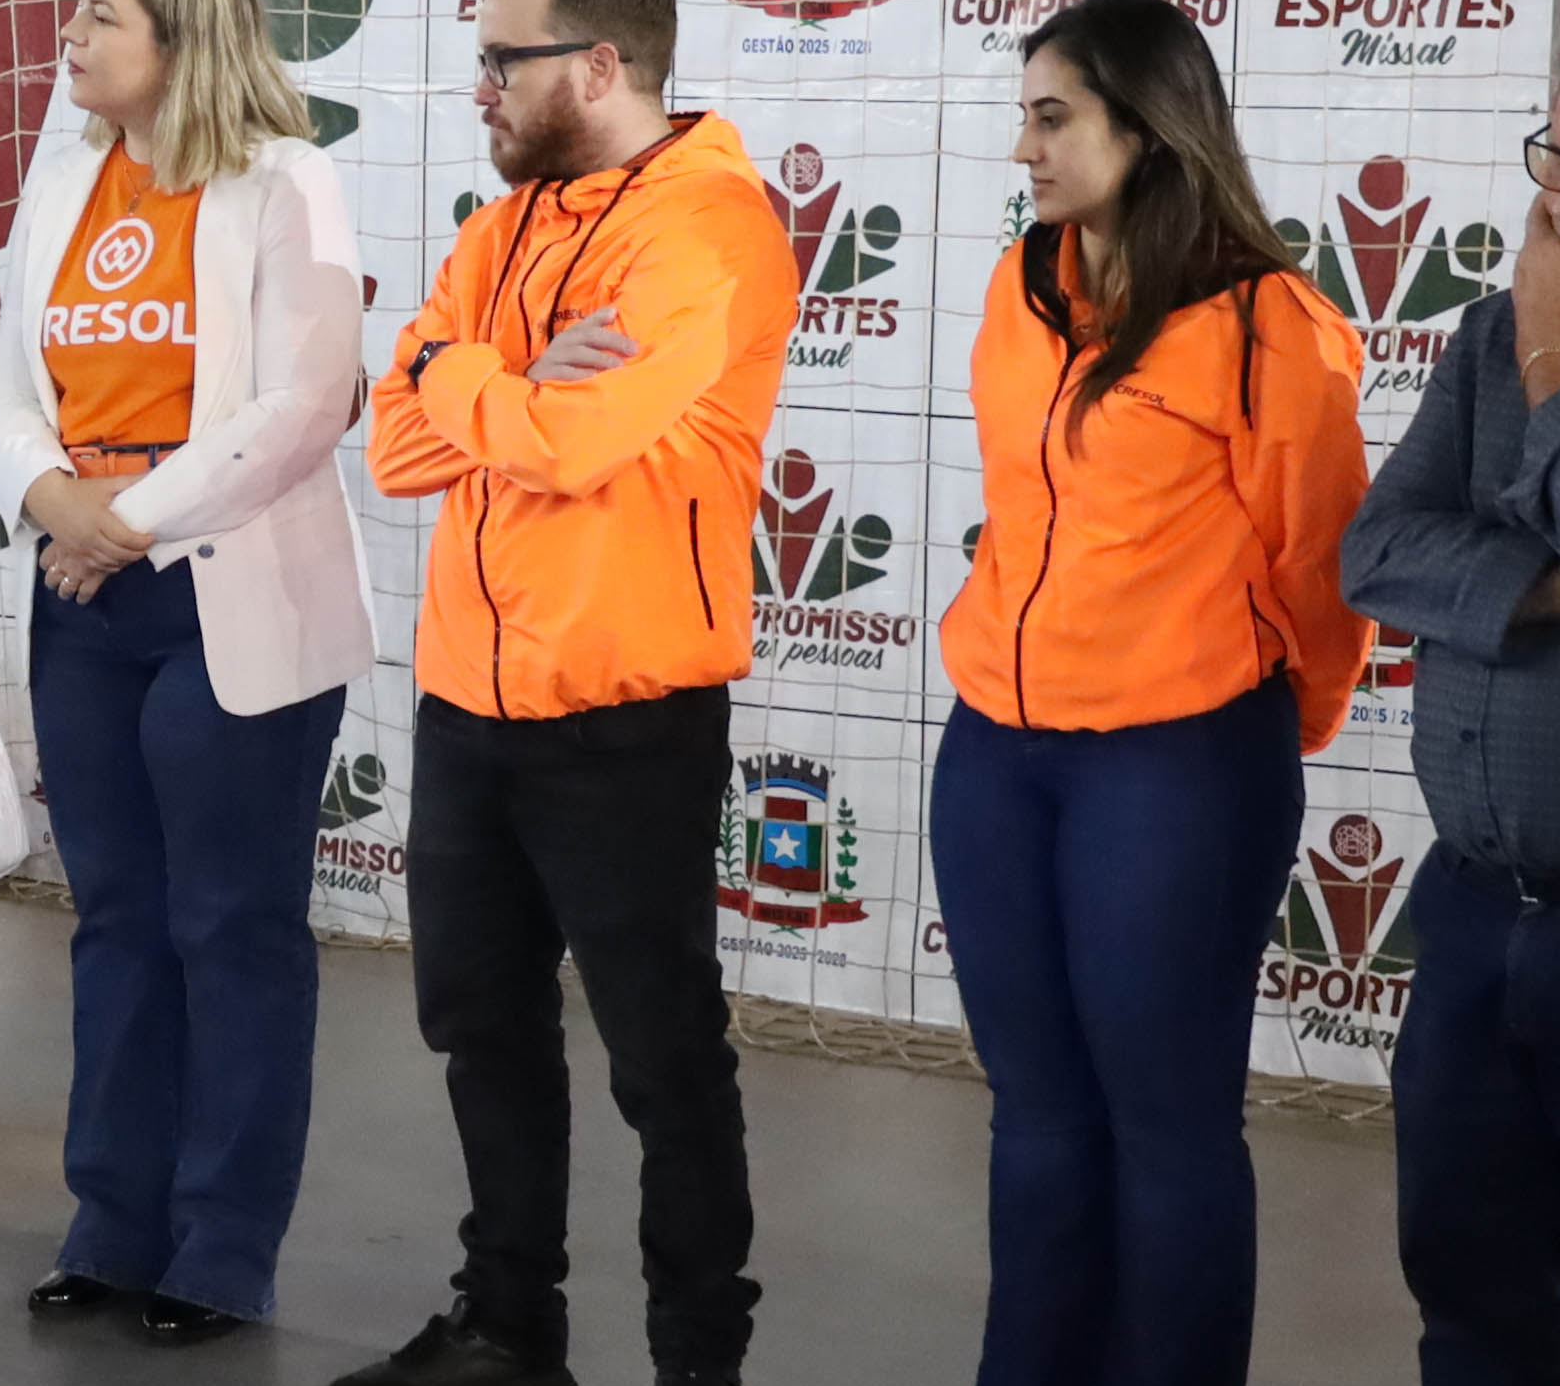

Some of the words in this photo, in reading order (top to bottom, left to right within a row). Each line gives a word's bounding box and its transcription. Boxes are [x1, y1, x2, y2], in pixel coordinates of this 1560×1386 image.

[741, 35, 794, 55] GESTÃO
[799, 37, 830, 55] 2025
[1341, 28, 1457, 67] Missal
[42, 300, 196, 350] RESOL
[799, 295, 900, 338] RTES
[786, 336, 853, 370] issal
[751, 600, 916, 648] PROMISSO
[778, 637, 886, 672] pessoas
[314, 867, 381, 895] essoas
[1257, 958, 1412, 1018] SPORT
[1298, 1004, 1396, 1050] Missa
